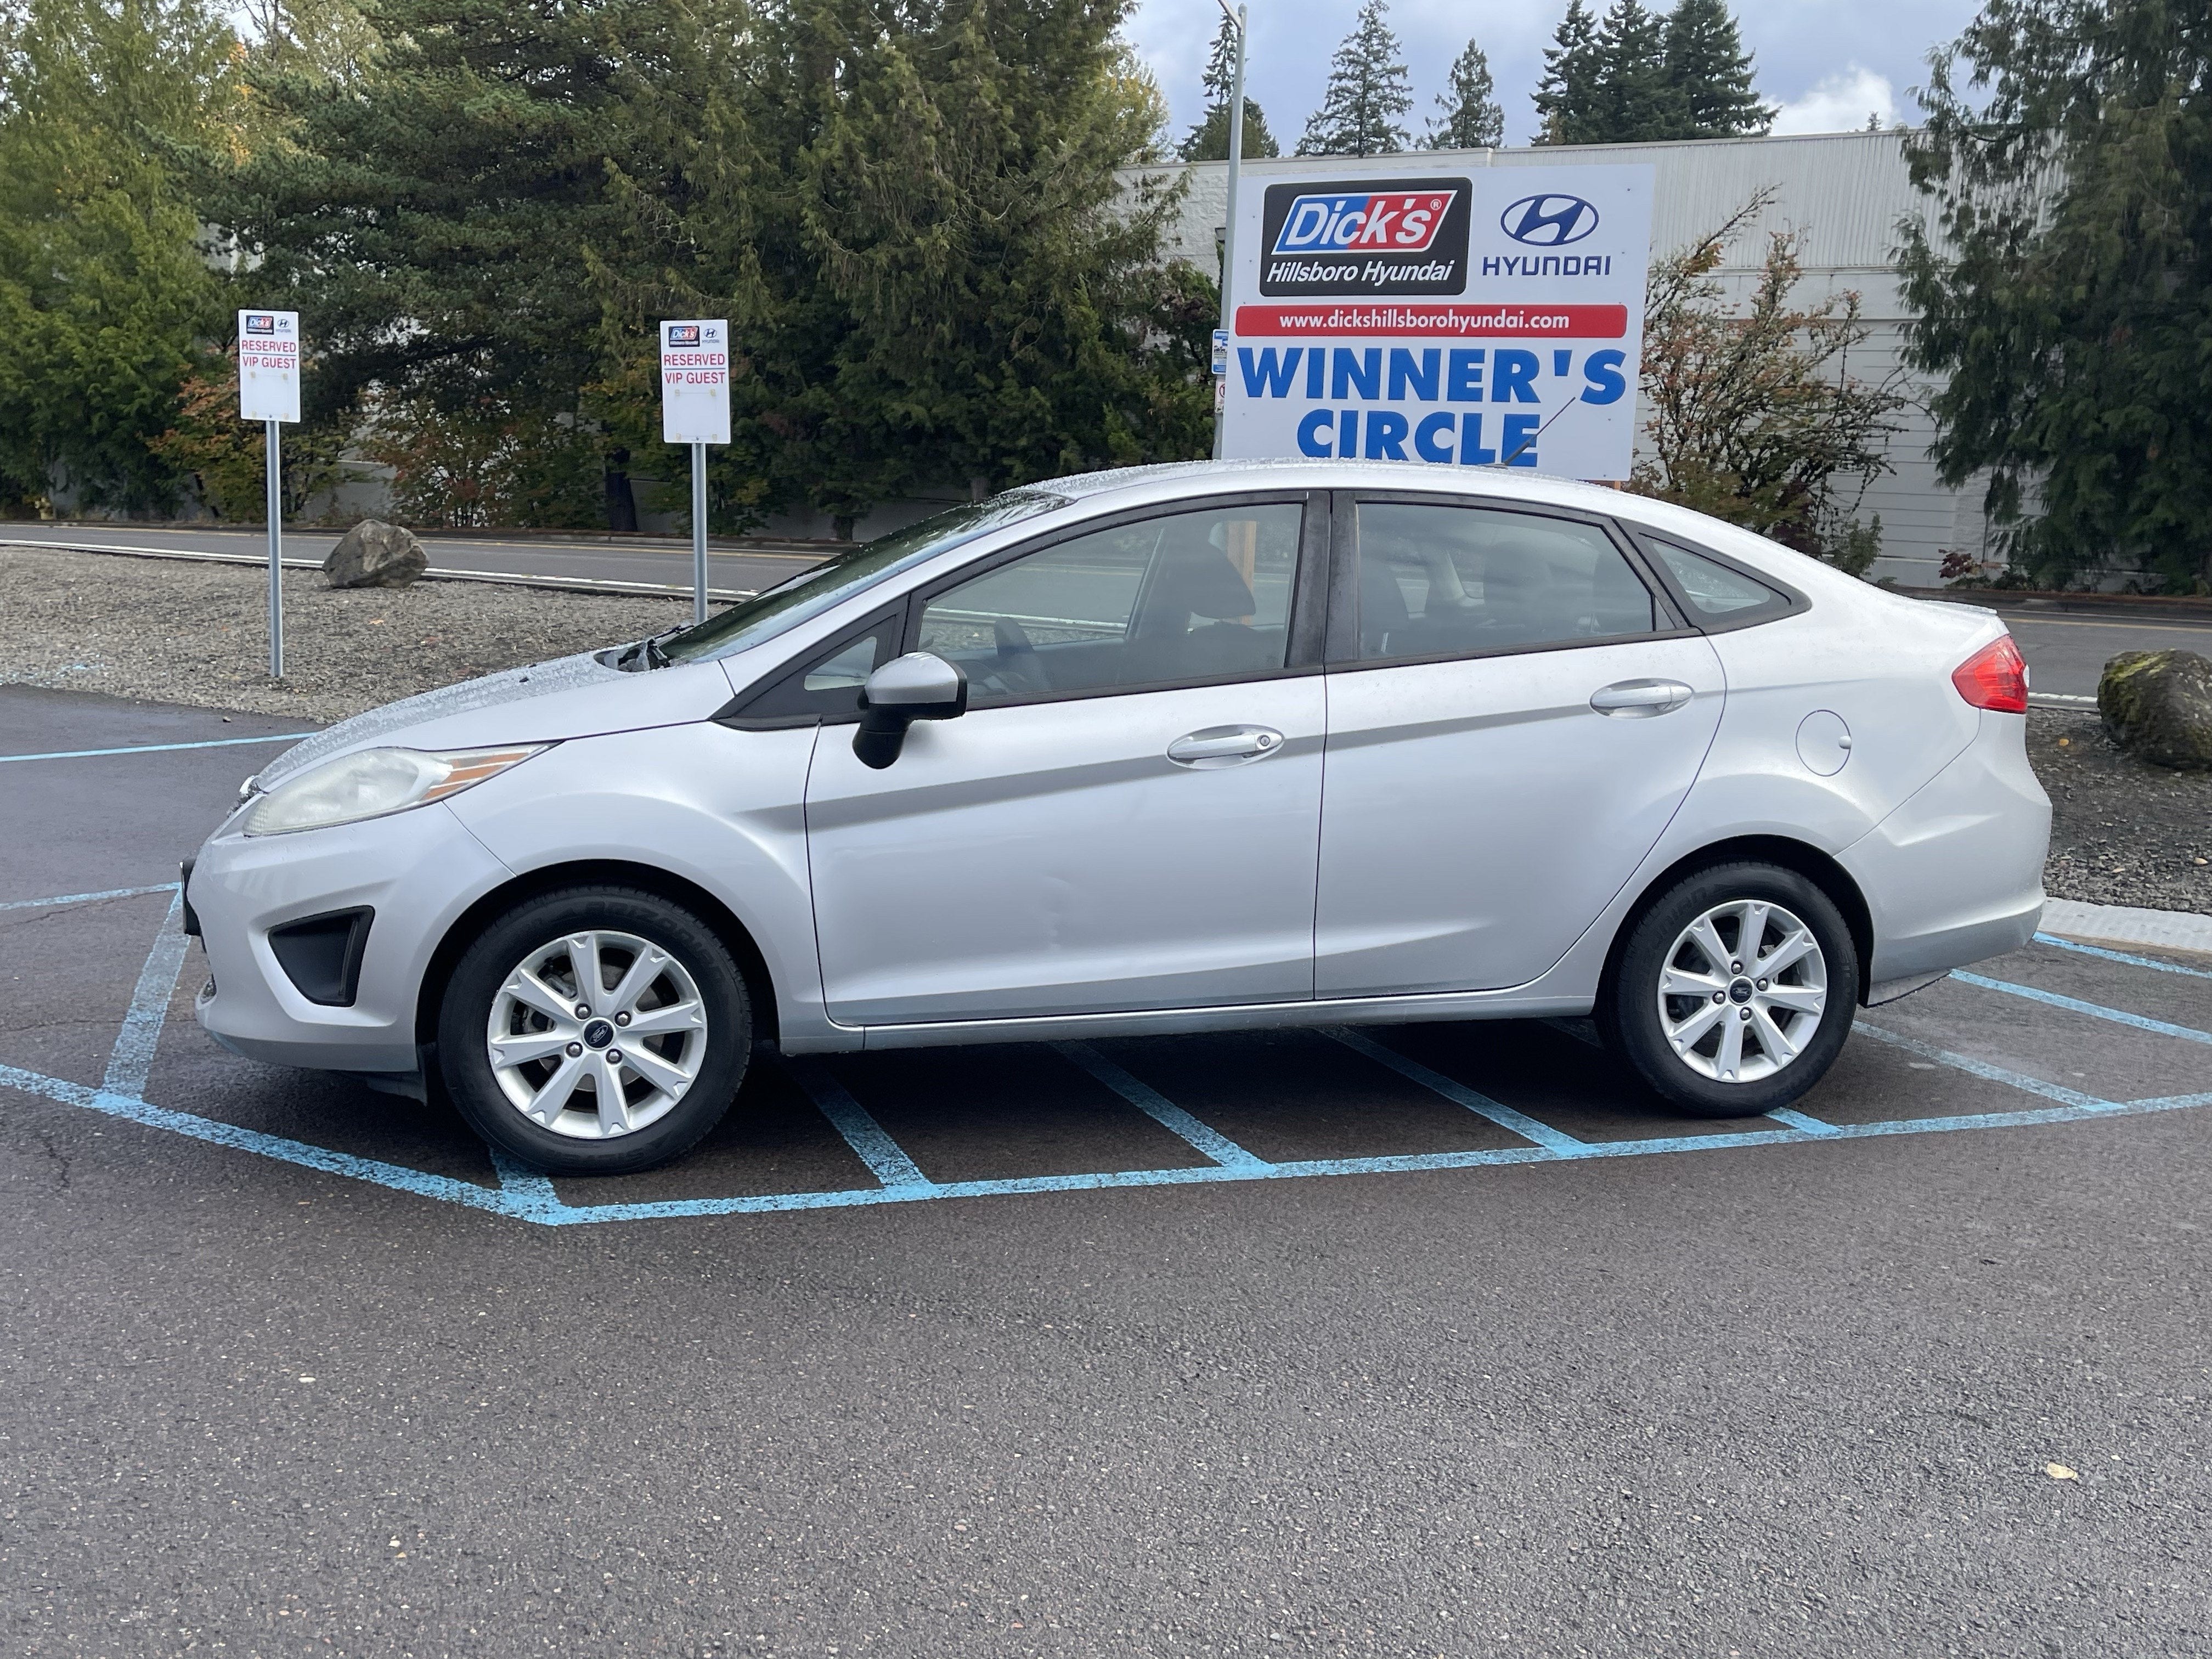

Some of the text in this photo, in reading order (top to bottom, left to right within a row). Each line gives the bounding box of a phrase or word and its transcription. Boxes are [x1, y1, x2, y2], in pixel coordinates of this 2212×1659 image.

[1285, 198, 1431, 246] Dick's
[1266, 260, 1455, 286] Hillsboro Hyundai
[1483, 256, 1610, 276] HYUNDAI
[1280, 309, 1570, 334] www.dickshillsborohyundai.com
[242, 340, 296, 353] RESERVED
[242, 356, 296, 369] VIP GUEST
[664, 354, 725, 366] RESERVED
[665, 372, 725, 384] VIP GUEST
[1238, 347, 1627, 405] WINNER'S
[1297, 409, 1540, 466] CIRCLE
